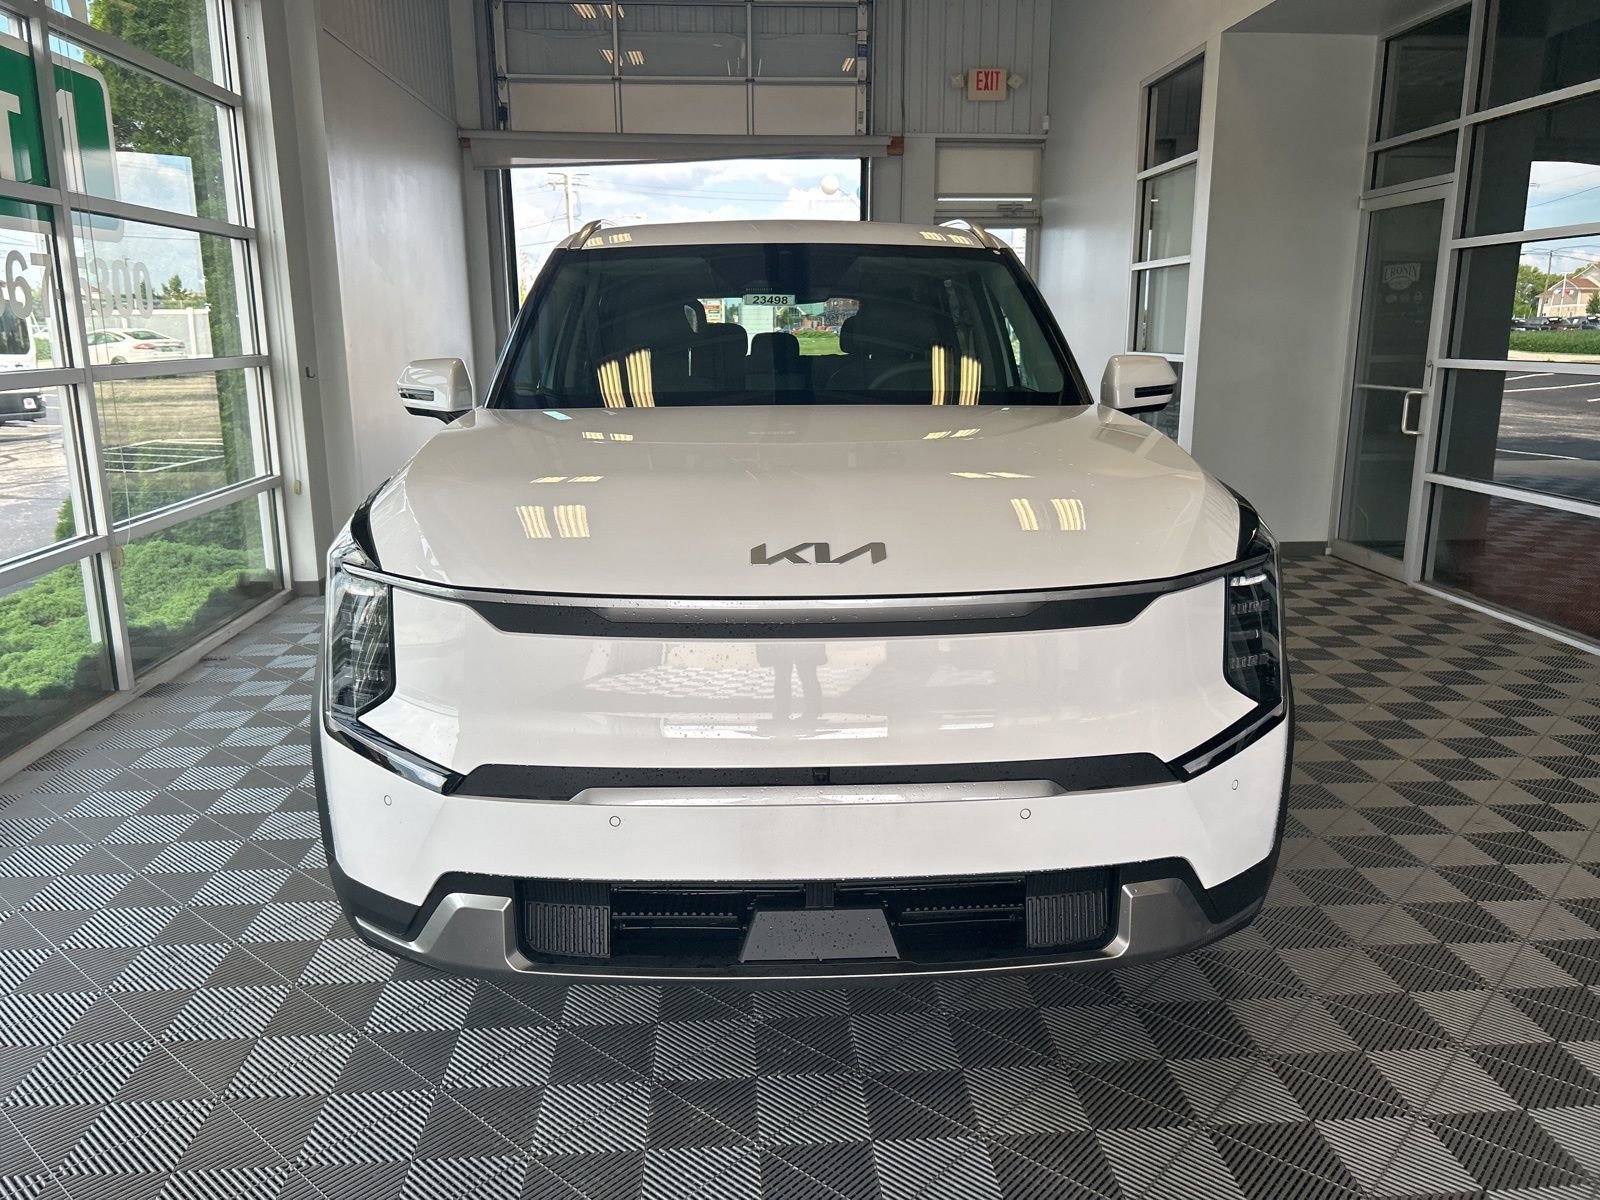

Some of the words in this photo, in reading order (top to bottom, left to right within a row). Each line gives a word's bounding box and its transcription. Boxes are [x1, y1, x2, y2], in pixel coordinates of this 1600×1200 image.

[975, 70, 1001, 91] EXIT
[753, 295, 789, 305] 23498
[750, 542, 887, 566] KIA
